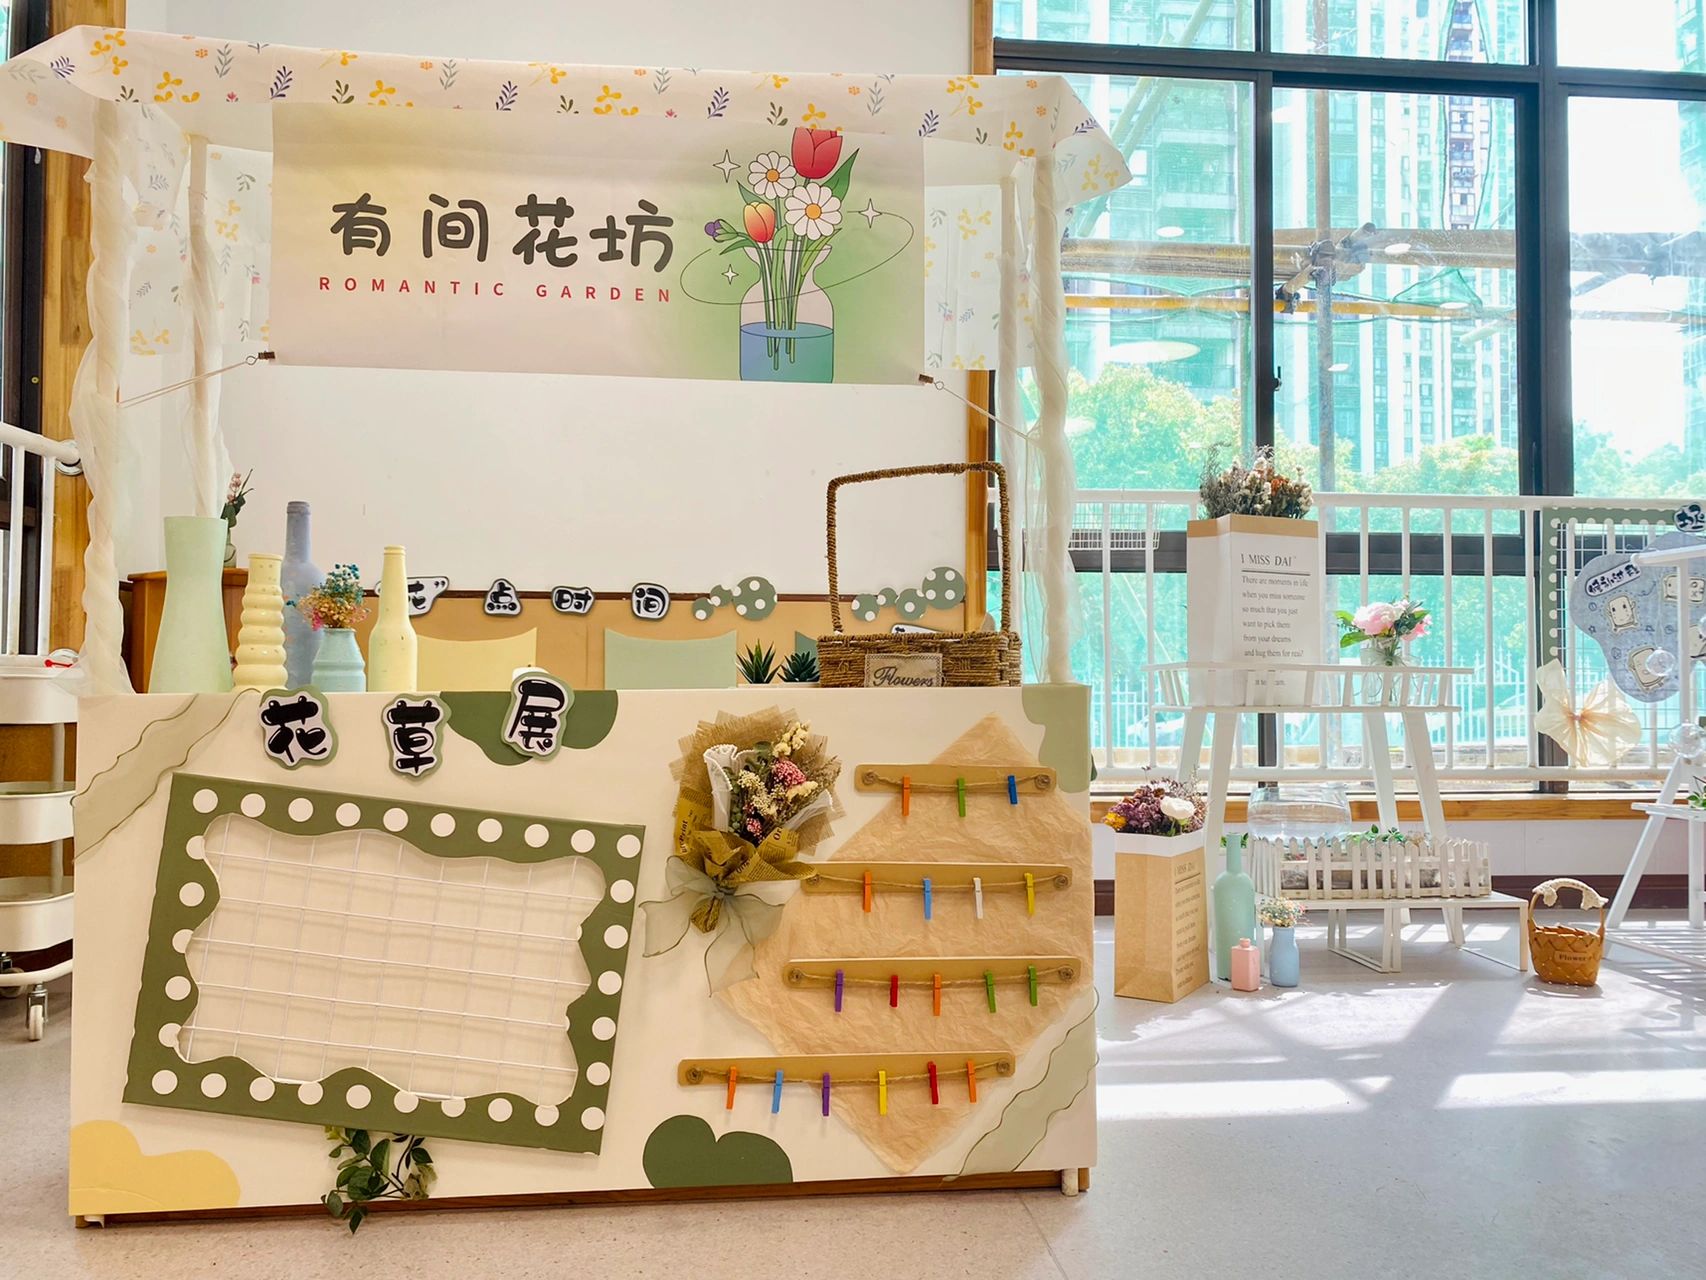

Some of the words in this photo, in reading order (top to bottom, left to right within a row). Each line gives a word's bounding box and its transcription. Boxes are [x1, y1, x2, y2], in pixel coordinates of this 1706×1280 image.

[330, 193, 675, 272] 有间花坊
[319, 276, 505, 297] ROMANTIC
[535, 283, 672, 303] GARDEN
[1249, 554, 1271, 566] MISS
[873, 666, 934, 687] Flowers
[261, 678, 566, 774] 花草展
